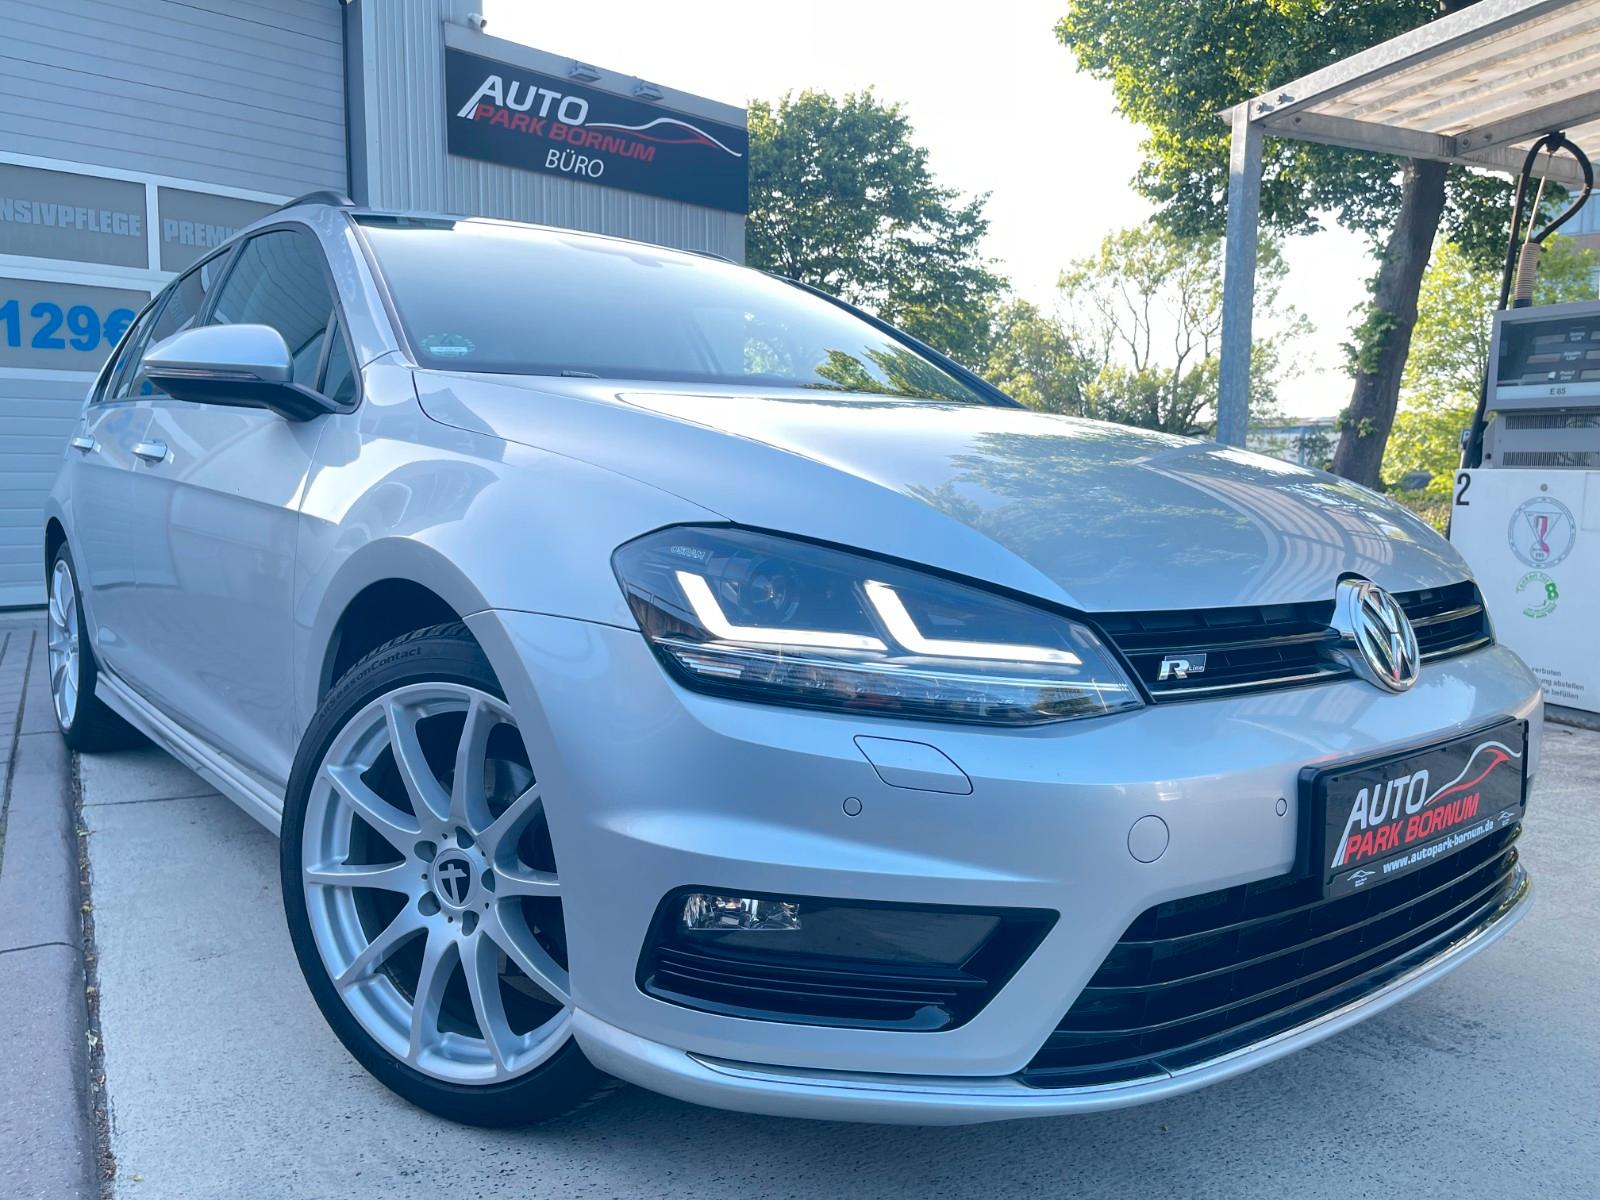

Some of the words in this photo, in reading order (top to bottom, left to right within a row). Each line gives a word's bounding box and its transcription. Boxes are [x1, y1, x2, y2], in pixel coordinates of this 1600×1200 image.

[457, 74, 589, 126] AUTO
[474, 103, 544, 137] PARK
[549, 123, 656, 162] BORNUM
[545, 147, 605, 178] BÜRO
[0, 198, 141, 237] NSIVPFLEGE
[163, 218, 240, 248] PREM
[1455, 473, 1472, 506] 2
[1157, 659, 1189, 681] R
[1331, 769, 1429, 868] AUTO
[1344, 821, 1403, 864] PARK
[1405, 792, 1480, 842] BORNUM
[1383, 819, 1494, 873] www.autopark-bornum.de
